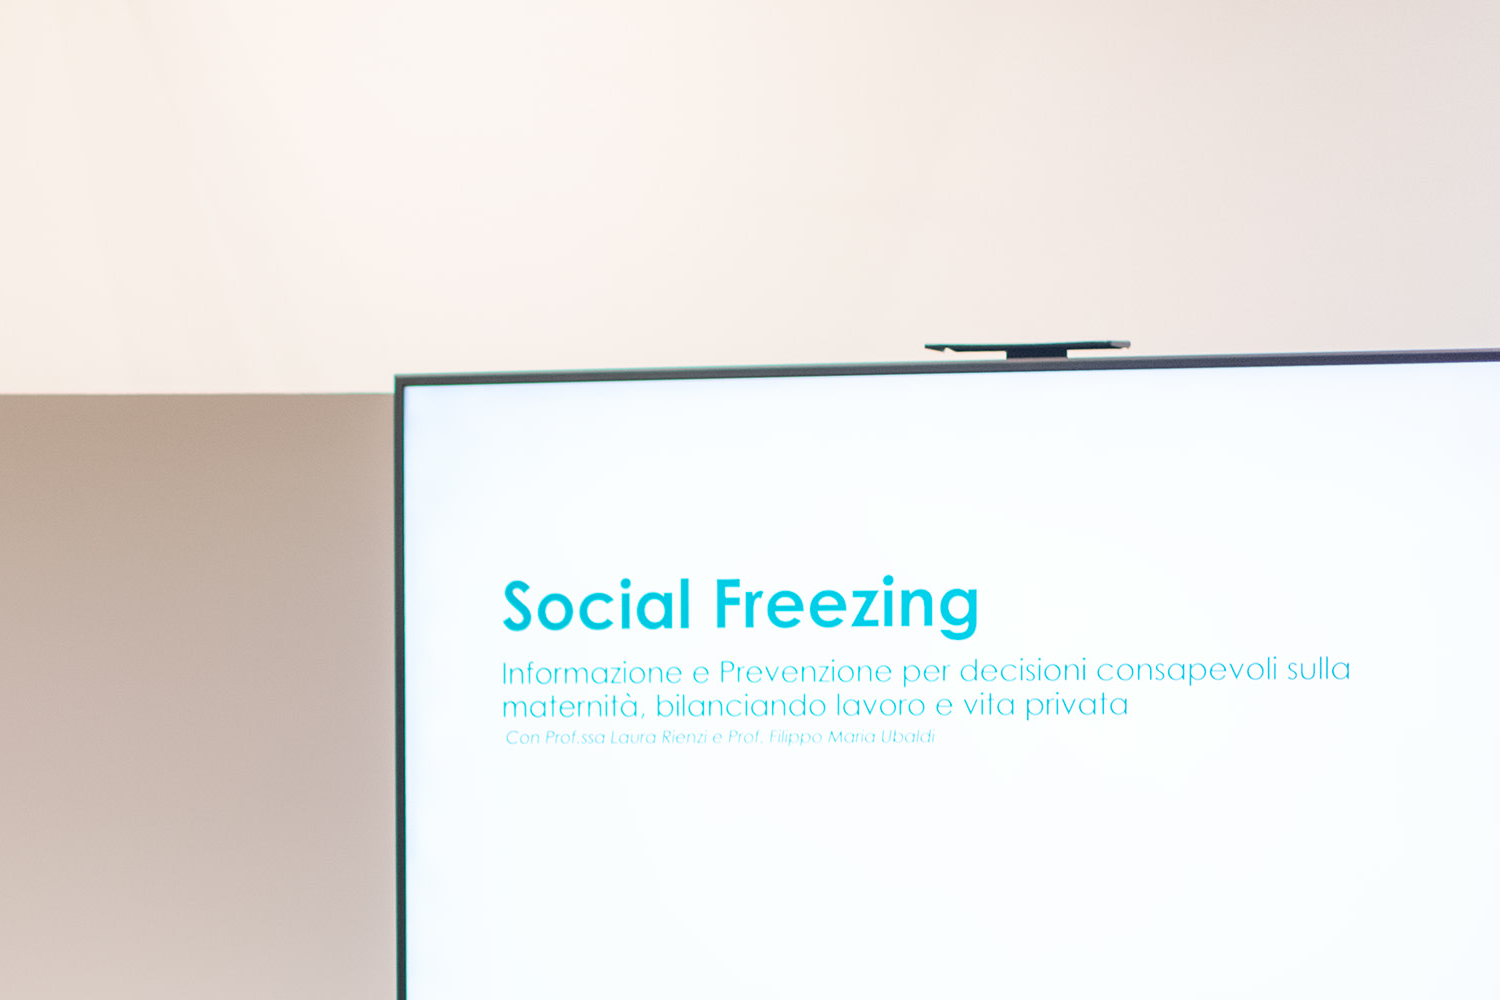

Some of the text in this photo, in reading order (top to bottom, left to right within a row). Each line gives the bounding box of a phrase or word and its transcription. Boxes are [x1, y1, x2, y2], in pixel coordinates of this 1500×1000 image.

[503, 574, 978, 641] Social Freezing
[503, 655, 1350, 688] Informazione e Prevenzione per decisioni consapevoli sulla
[503, 691, 1128, 721] maternità, bilanciando lavoro e vita privata
[505, 730, 540, 745] Con
[610, 730, 657, 745] Laura
[661, 728, 708, 744] Rienzi
[712, 733, 723, 744] e
[728, 728, 764, 744] Prof.
[769, 728, 823, 747] Filippo
[827, 728, 876, 744] Maria
[880, 728, 936, 744] Ubaldi
